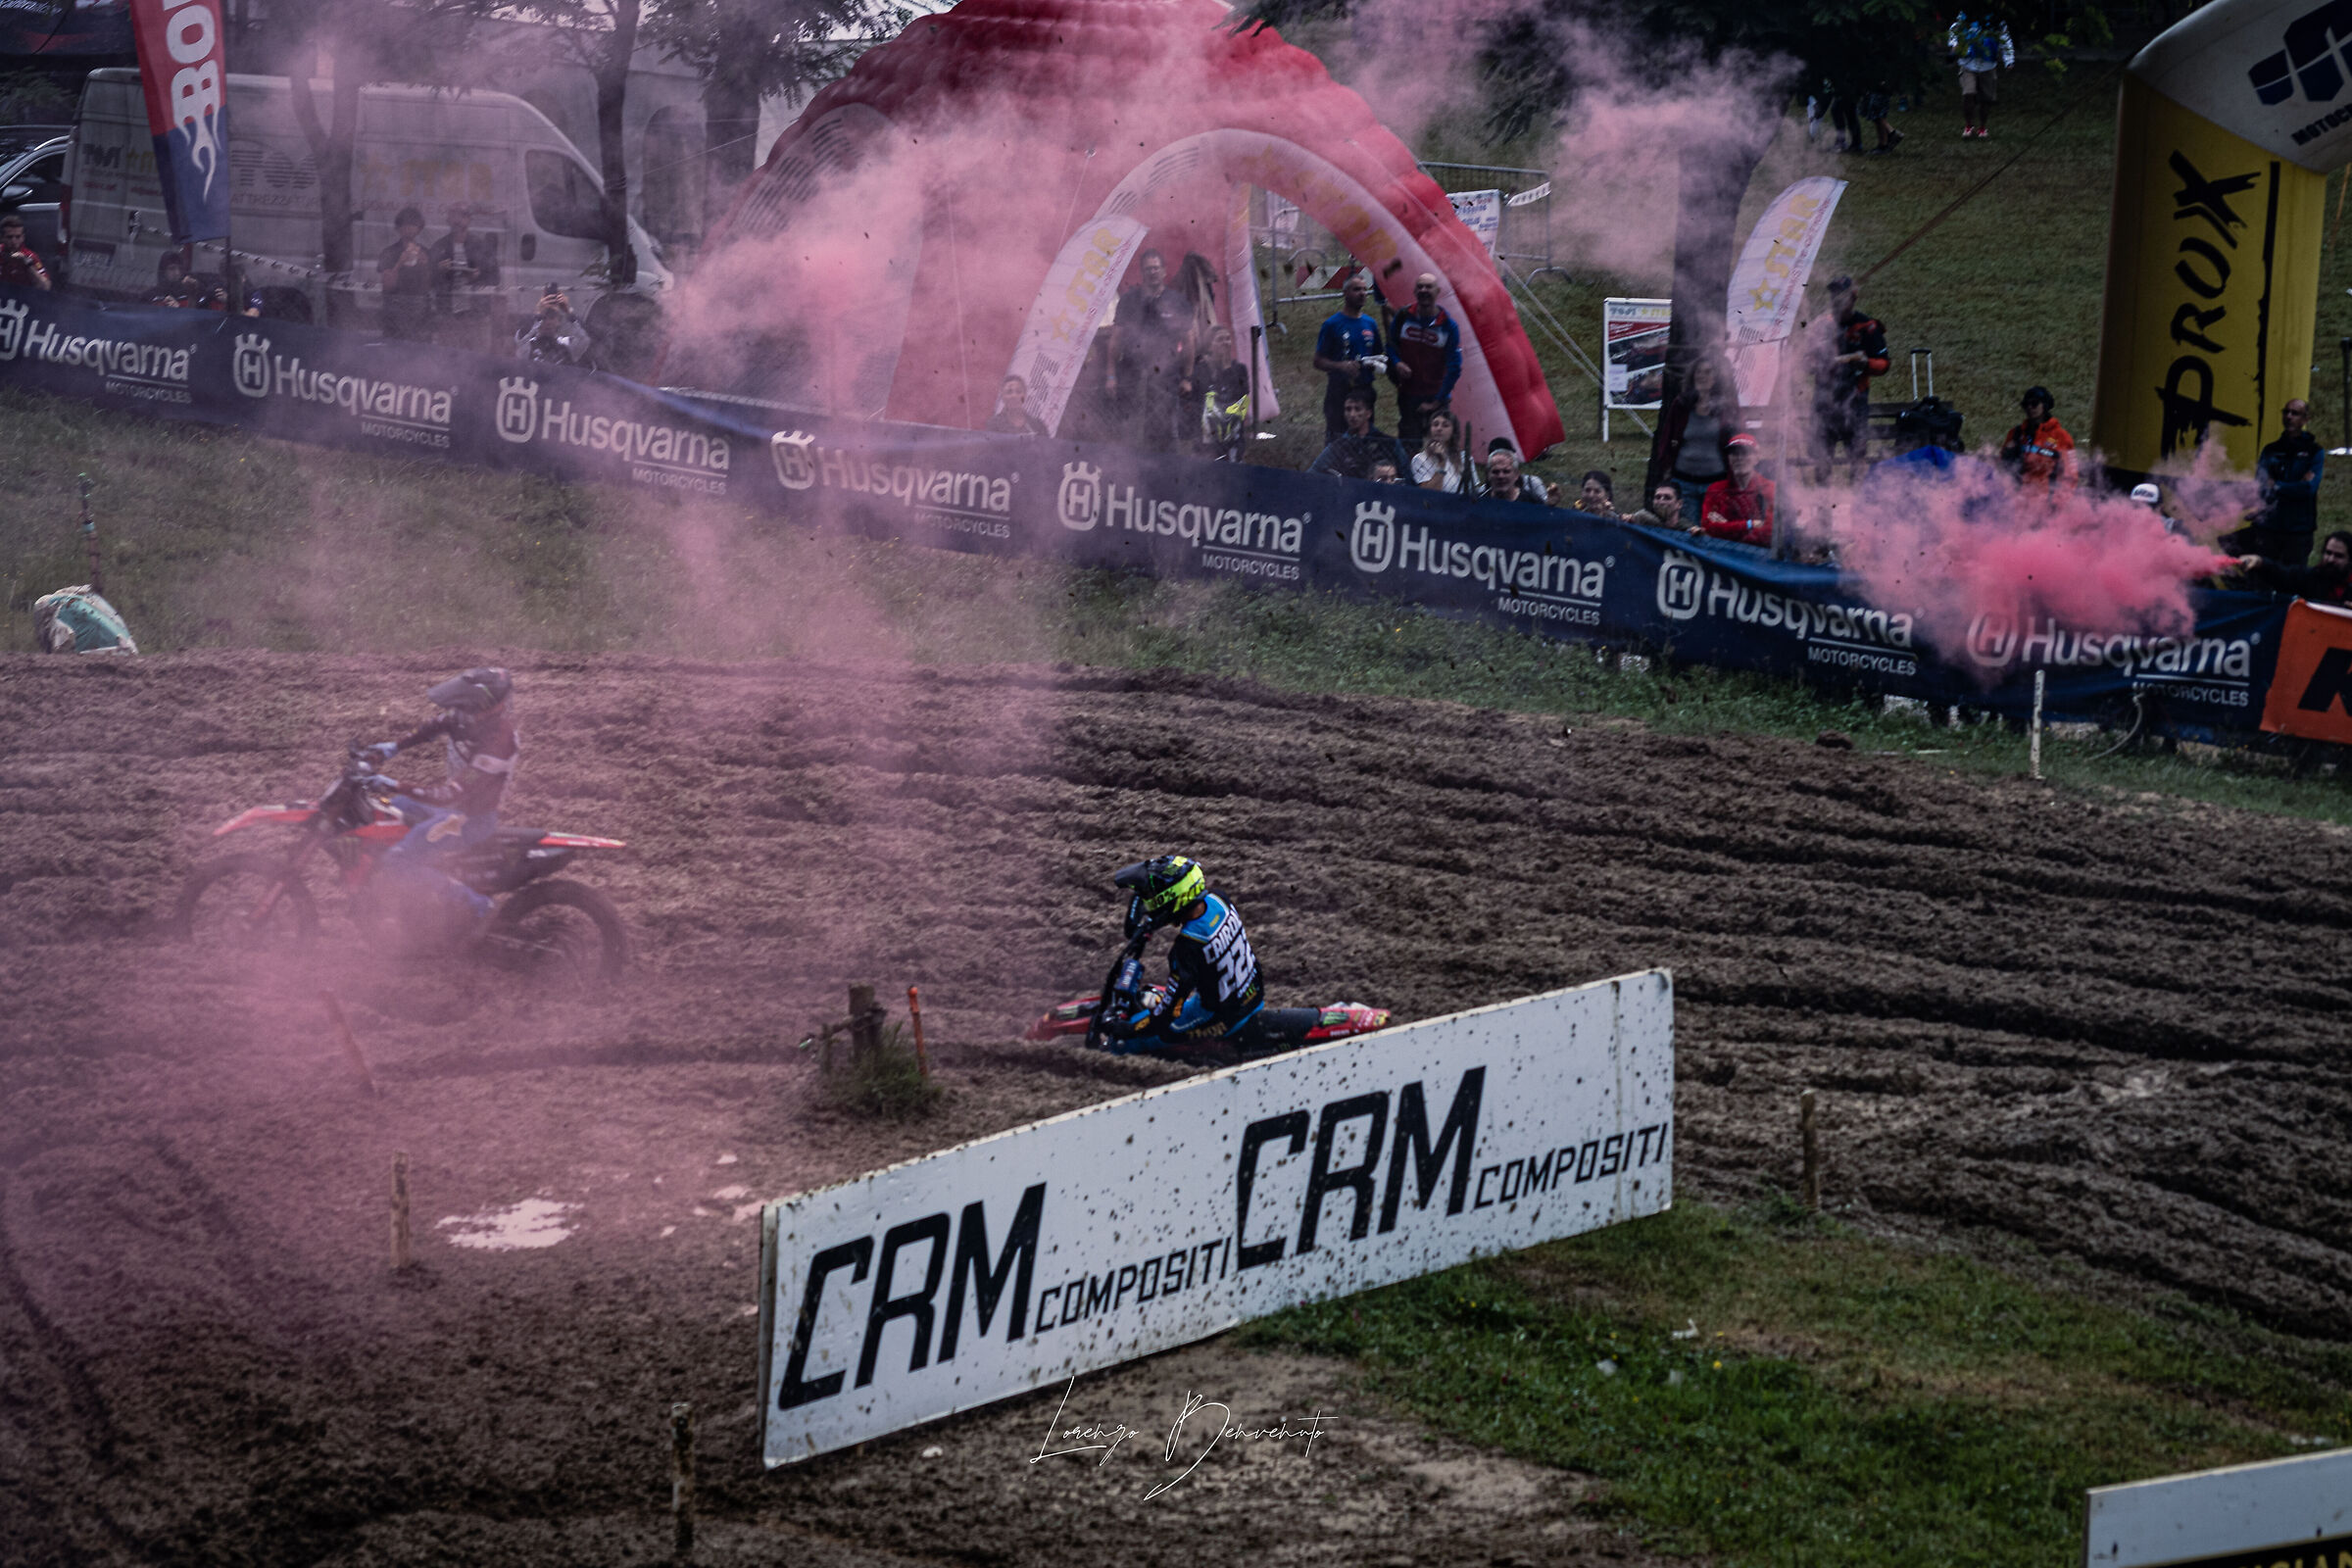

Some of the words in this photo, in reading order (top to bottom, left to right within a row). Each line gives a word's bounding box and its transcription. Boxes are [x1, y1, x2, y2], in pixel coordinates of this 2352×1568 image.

[162, 0, 223, 149] BO
[24, 319, 189, 381] Husqvarna
[106, 380, 192, 404] MOTORCYCLES
[274, 355, 452, 424] Husqvarna
[362, 421, 450, 448] MOTORCYCLES
[541, 397, 729, 470] Husqvarna
[632, 467, 727, 495] MOTORCYCLES
[816, 446, 1011, 512] Husqvarna
[1104, 481, 1301, 553] Husqvarna
[1201, 553, 1300, 581] MOTORCYCLES
[1398, 523, 1604, 599] Husqvarna
[1497, 596, 1600, 626] MOTORCYCLES
[1707, 572, 1914, 648] Husqvarna
[1807, 646, 1916, 677] MOTORCYCLES
[2022, 615, 2251, 678] Husqvarna
[1237, 1064, 1488, 1271] CRM
[1474, 1123, 1668, 1209] COMPOSITI
[779, 1181, 1048, 1409] CRM
[1035, 1236, 1233, 1334] COMPOSITI
